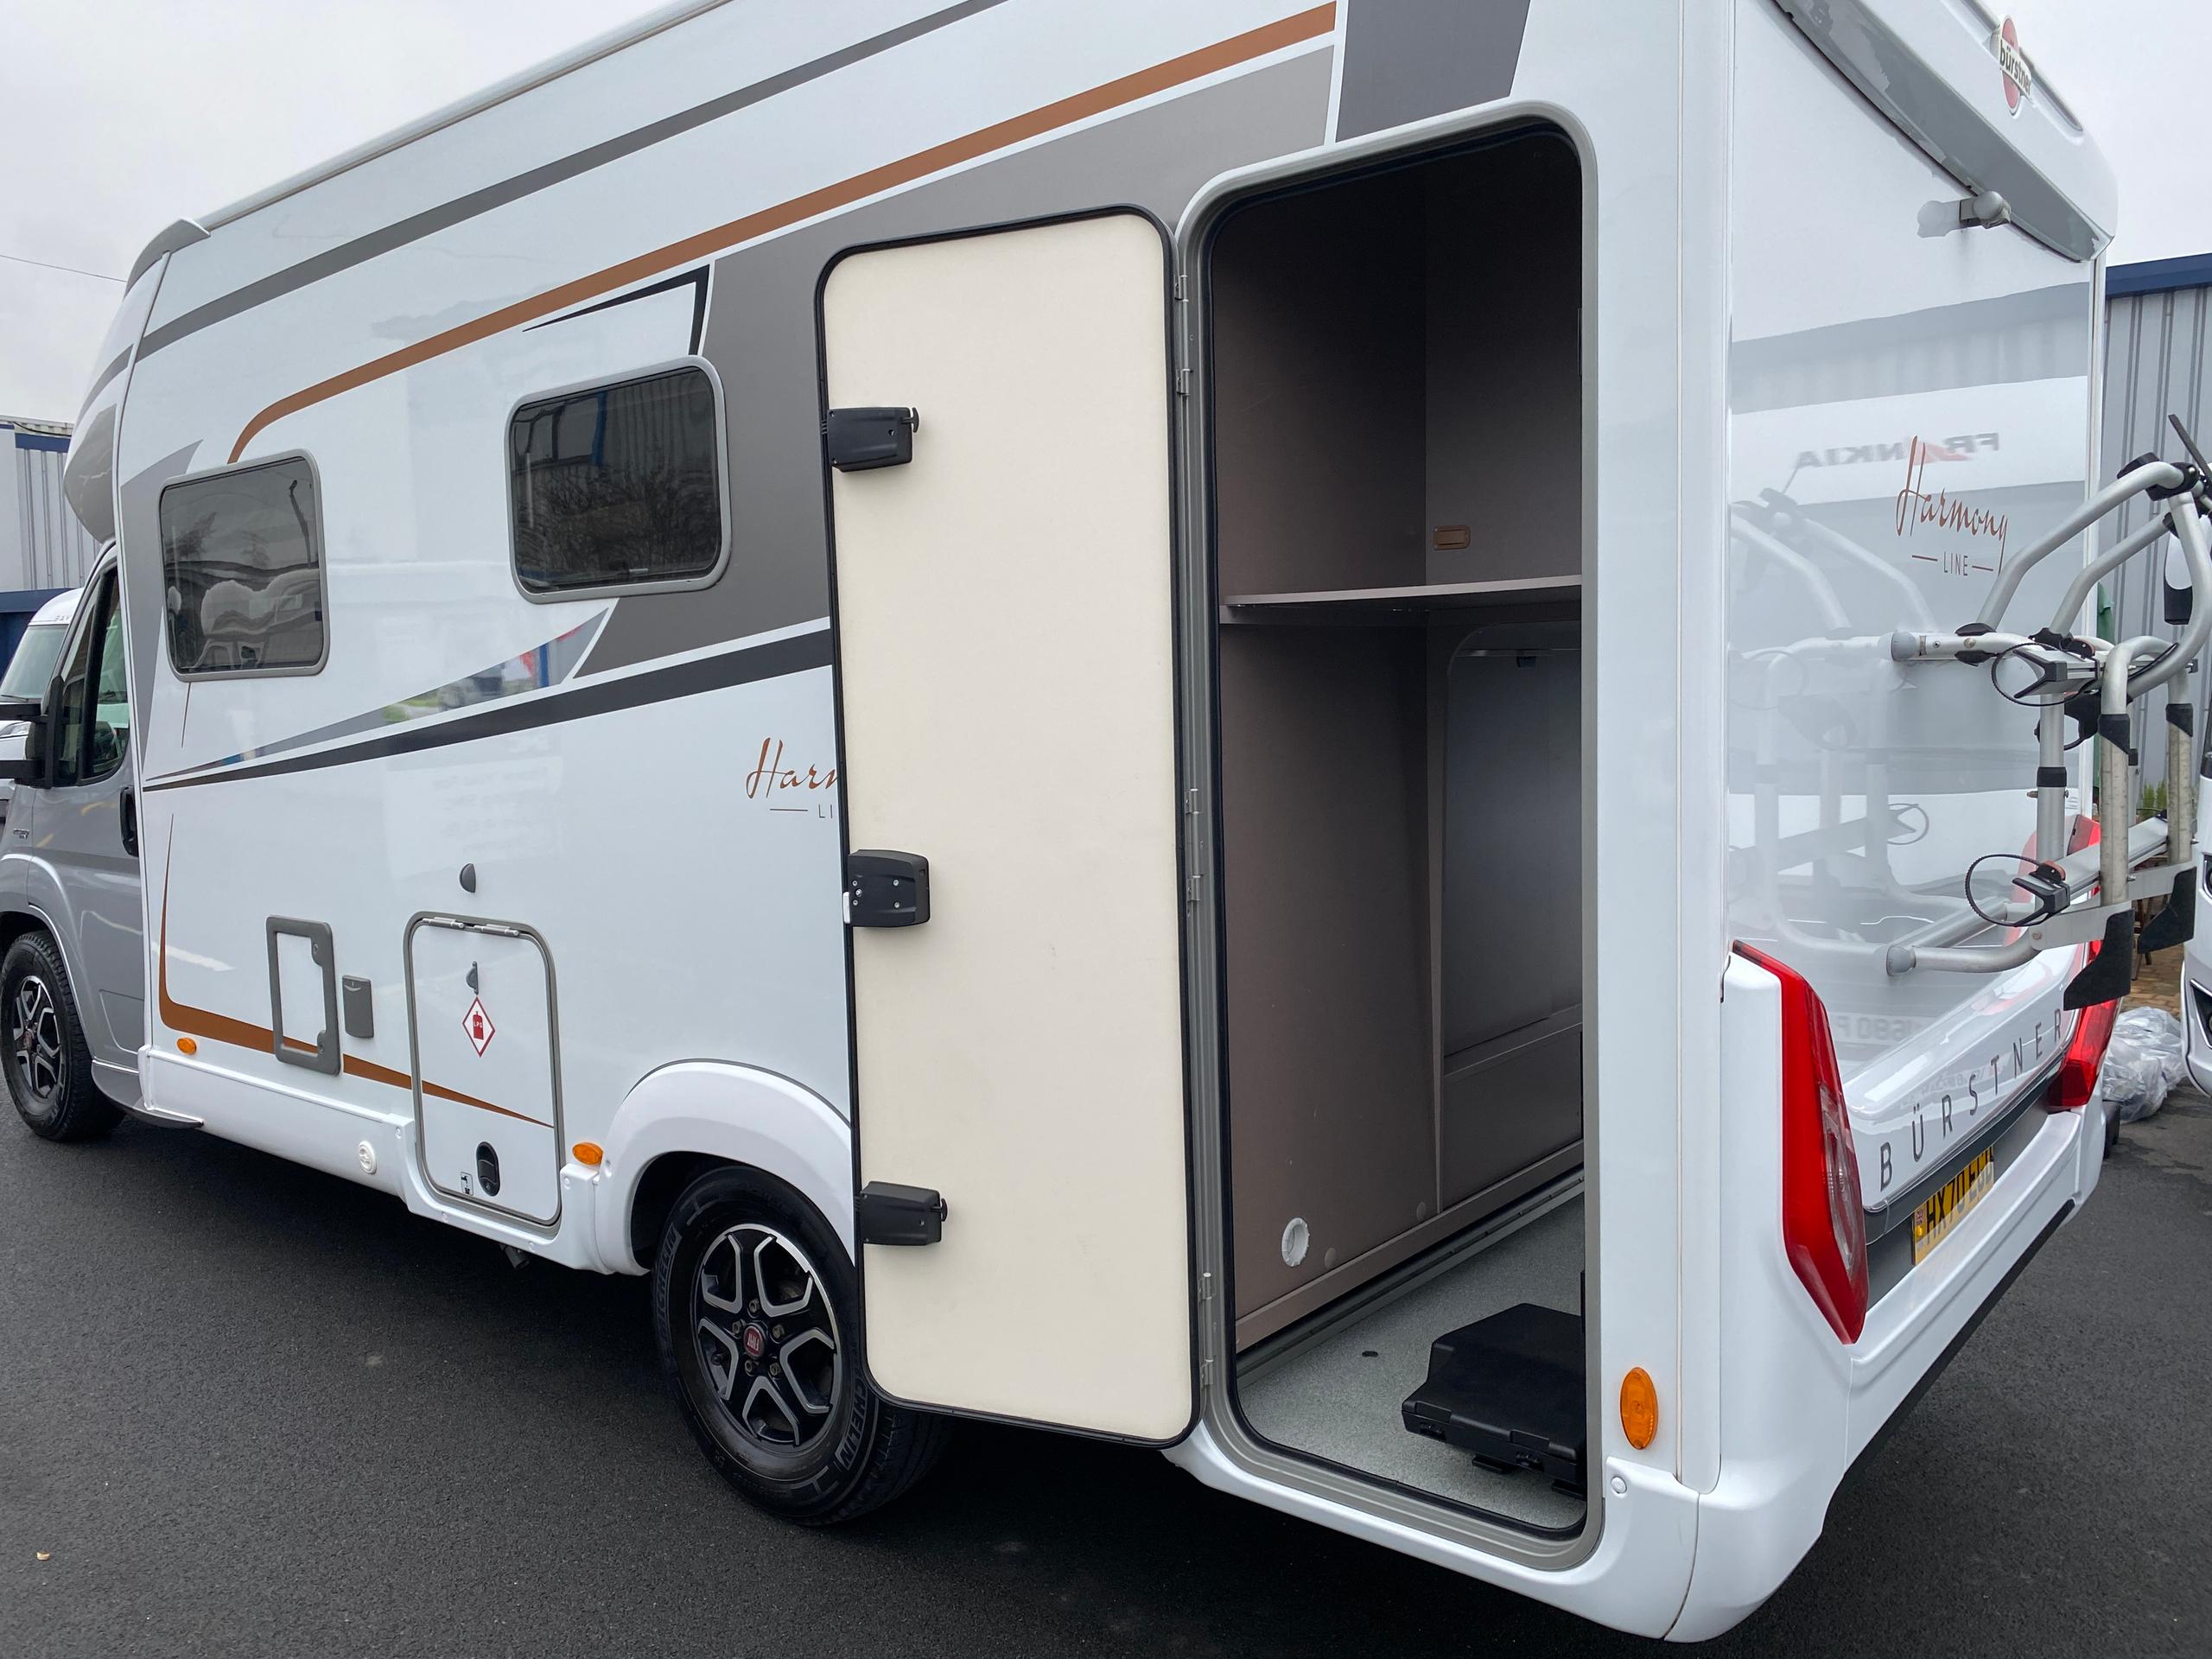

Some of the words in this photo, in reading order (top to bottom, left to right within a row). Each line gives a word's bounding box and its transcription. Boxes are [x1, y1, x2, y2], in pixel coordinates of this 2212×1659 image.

[1895, 435, 2009, 577] Harmony
[1943, 551, 1969, 577] LINE
[818, 804, 833, 819] LI
[1879, 1008, 2062, 1192] BÜRSTNER
